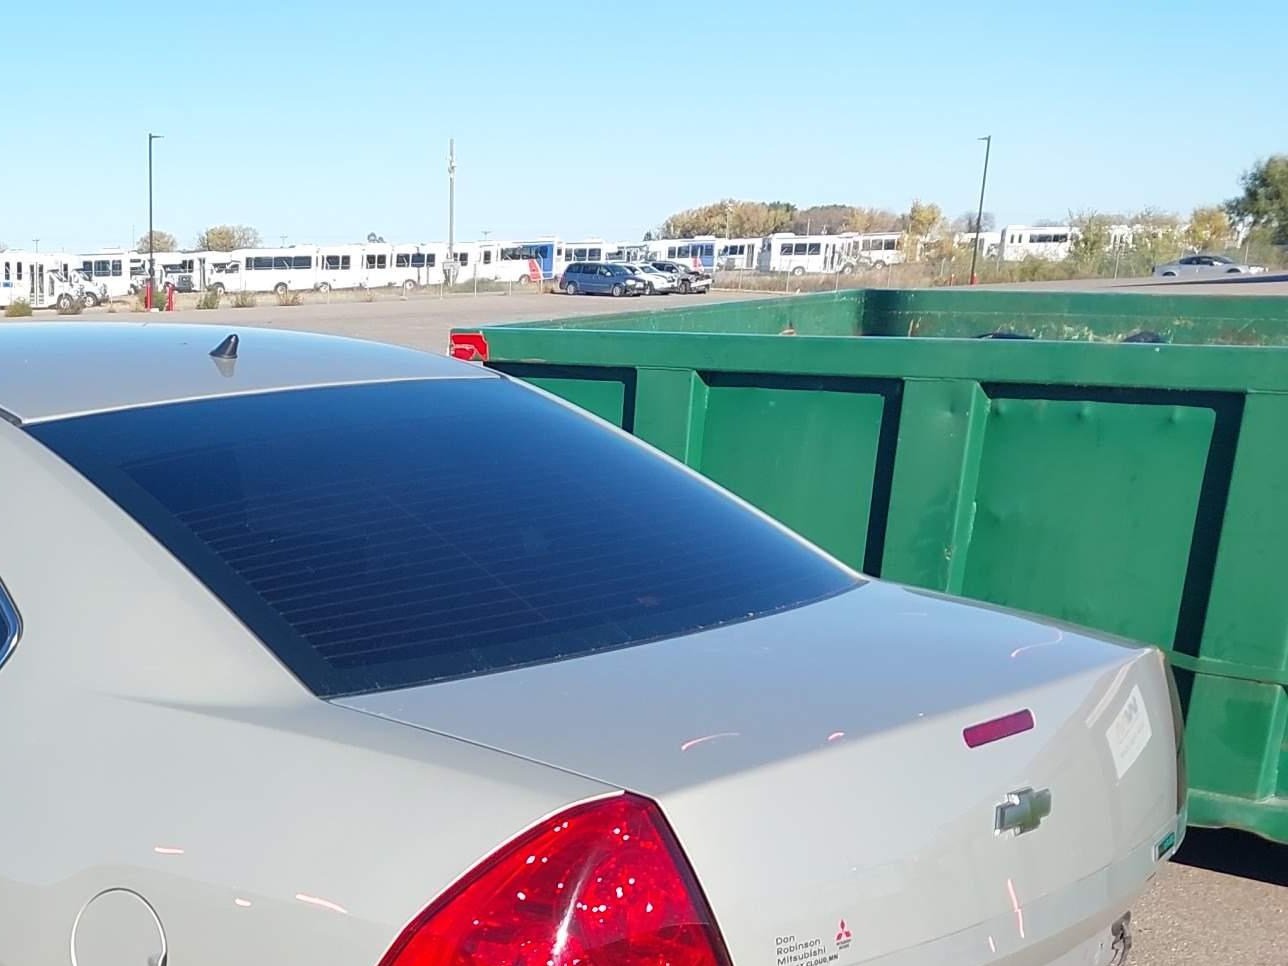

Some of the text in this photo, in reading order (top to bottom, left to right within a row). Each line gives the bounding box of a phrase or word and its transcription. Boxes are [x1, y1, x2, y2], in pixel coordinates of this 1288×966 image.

[775, 935, 795, 946] Don
[776, 938, 822, 956] Robinson
[777, 945, 826, 966] Mitsubishi
